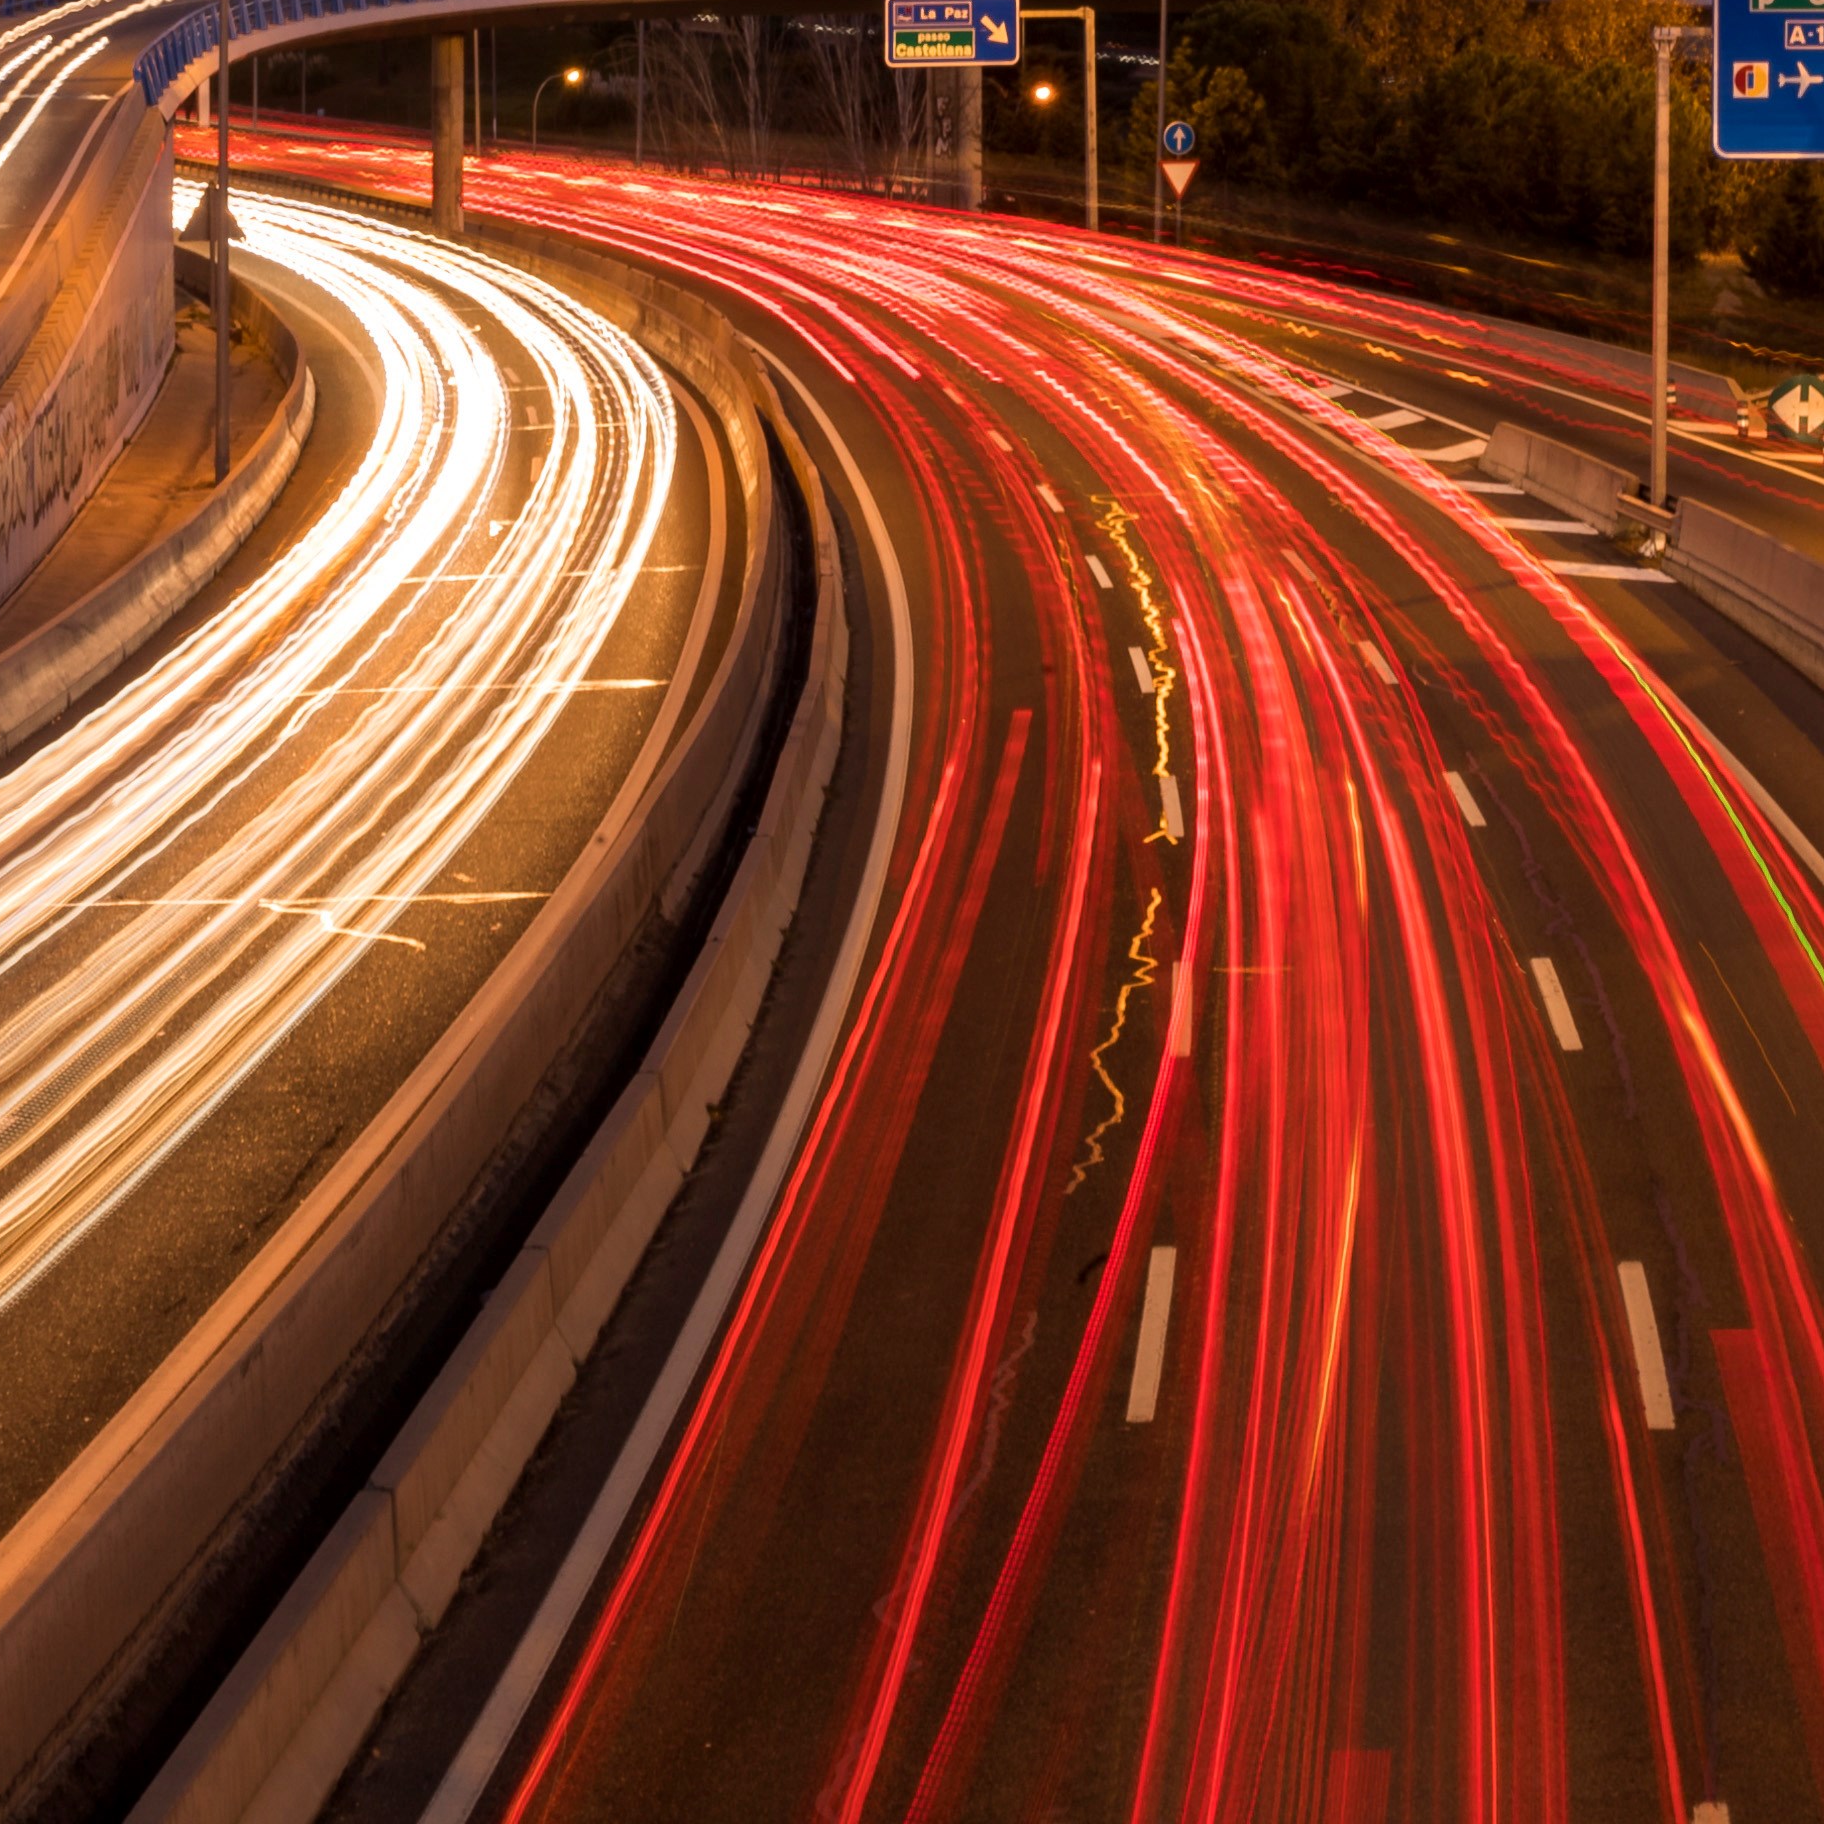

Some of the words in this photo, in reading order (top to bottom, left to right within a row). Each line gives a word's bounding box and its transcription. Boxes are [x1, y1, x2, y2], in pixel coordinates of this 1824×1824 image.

[920, 7, 936, 20] La
[944, 7, 969, 20] Paz
[896, 43, 973, 57] Castellana
